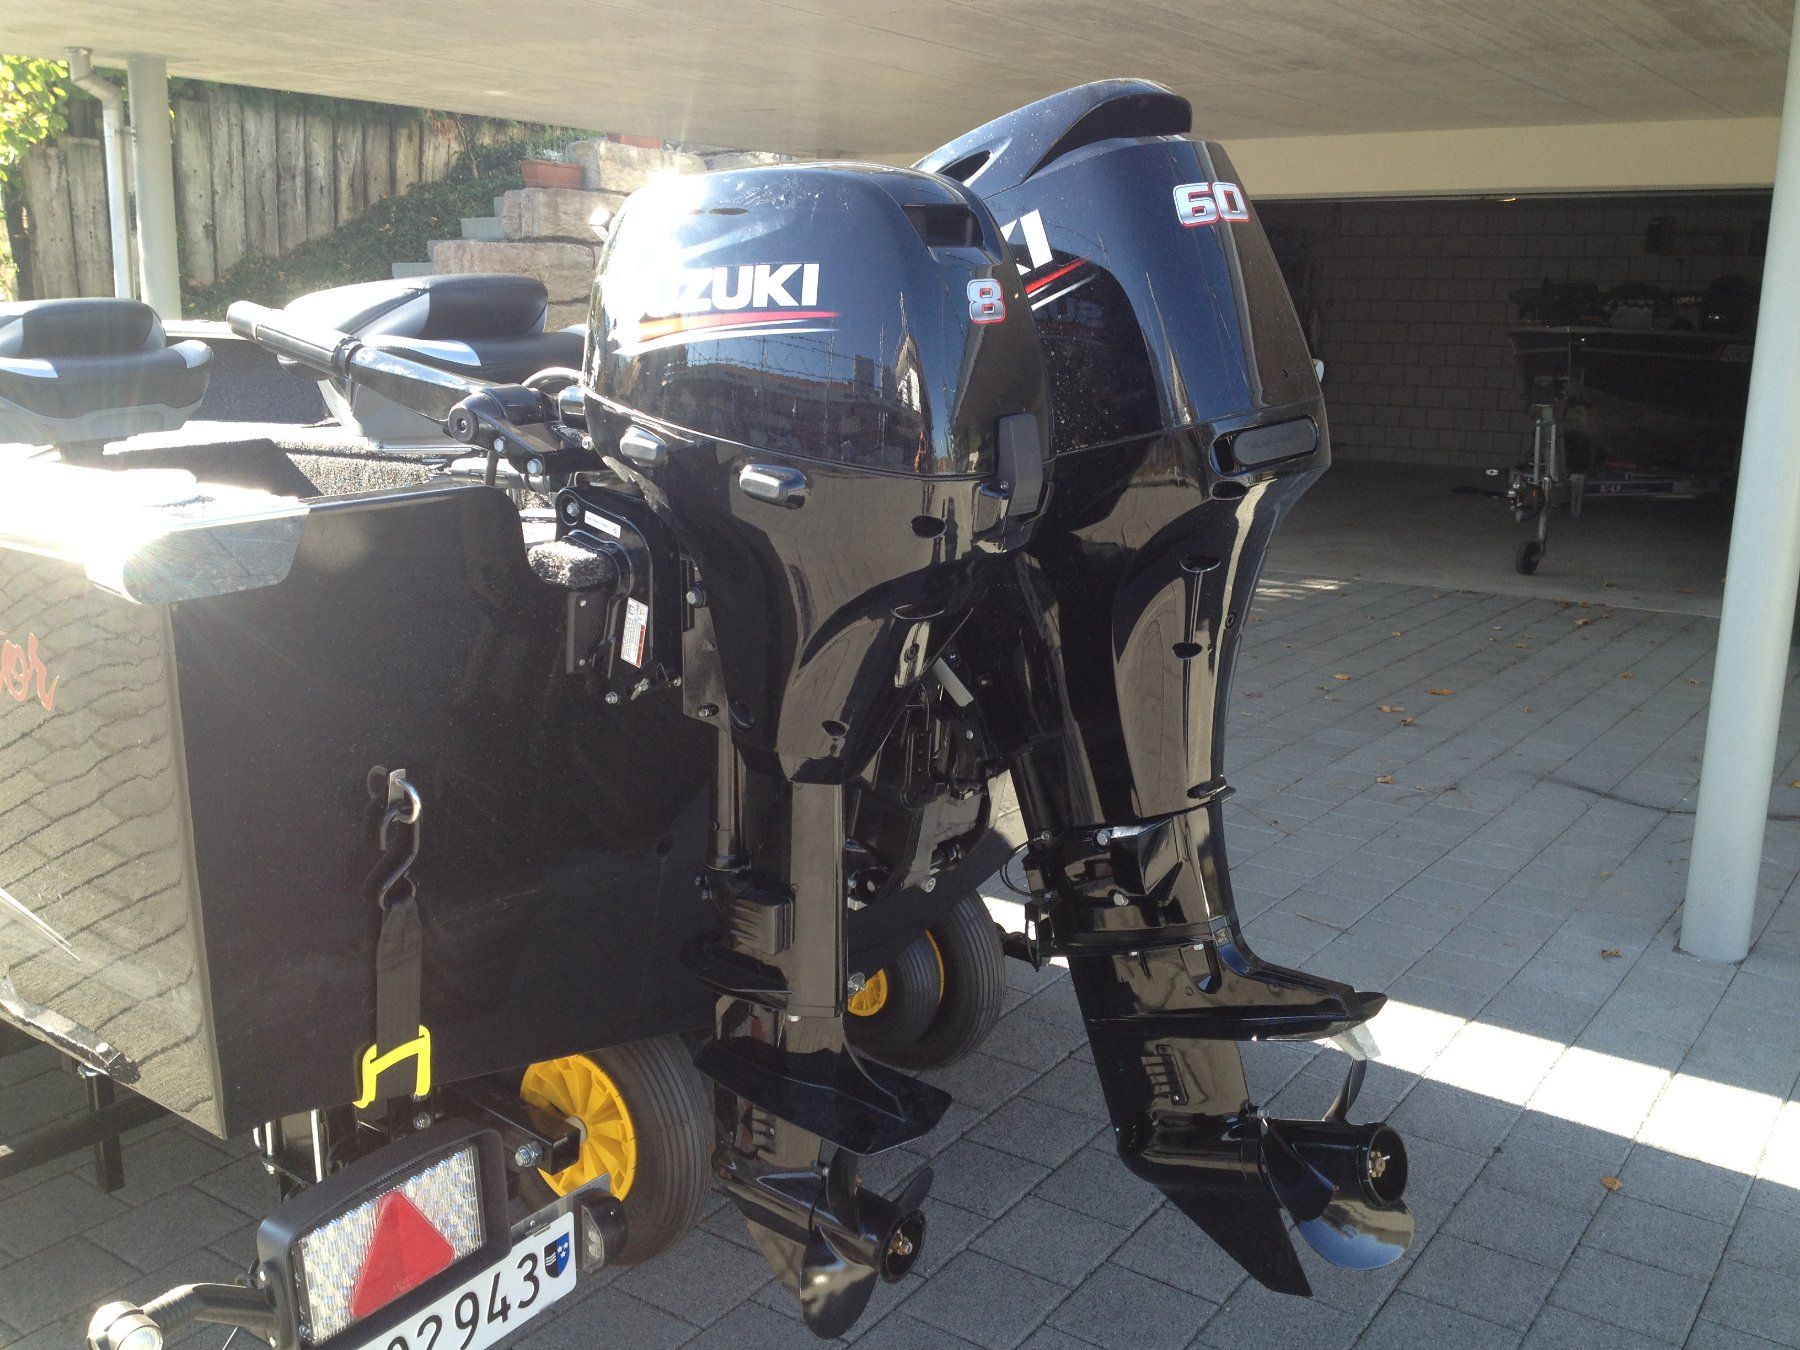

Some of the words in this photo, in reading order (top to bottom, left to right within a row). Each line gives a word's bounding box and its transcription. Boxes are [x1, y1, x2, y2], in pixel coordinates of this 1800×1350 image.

[1173, 182, 1250, 227] 60
[615, 262, 820, 318] ZUKI
[966, 278, 1006, 324] 8
[386, 1252, 540, 1350] 2943
